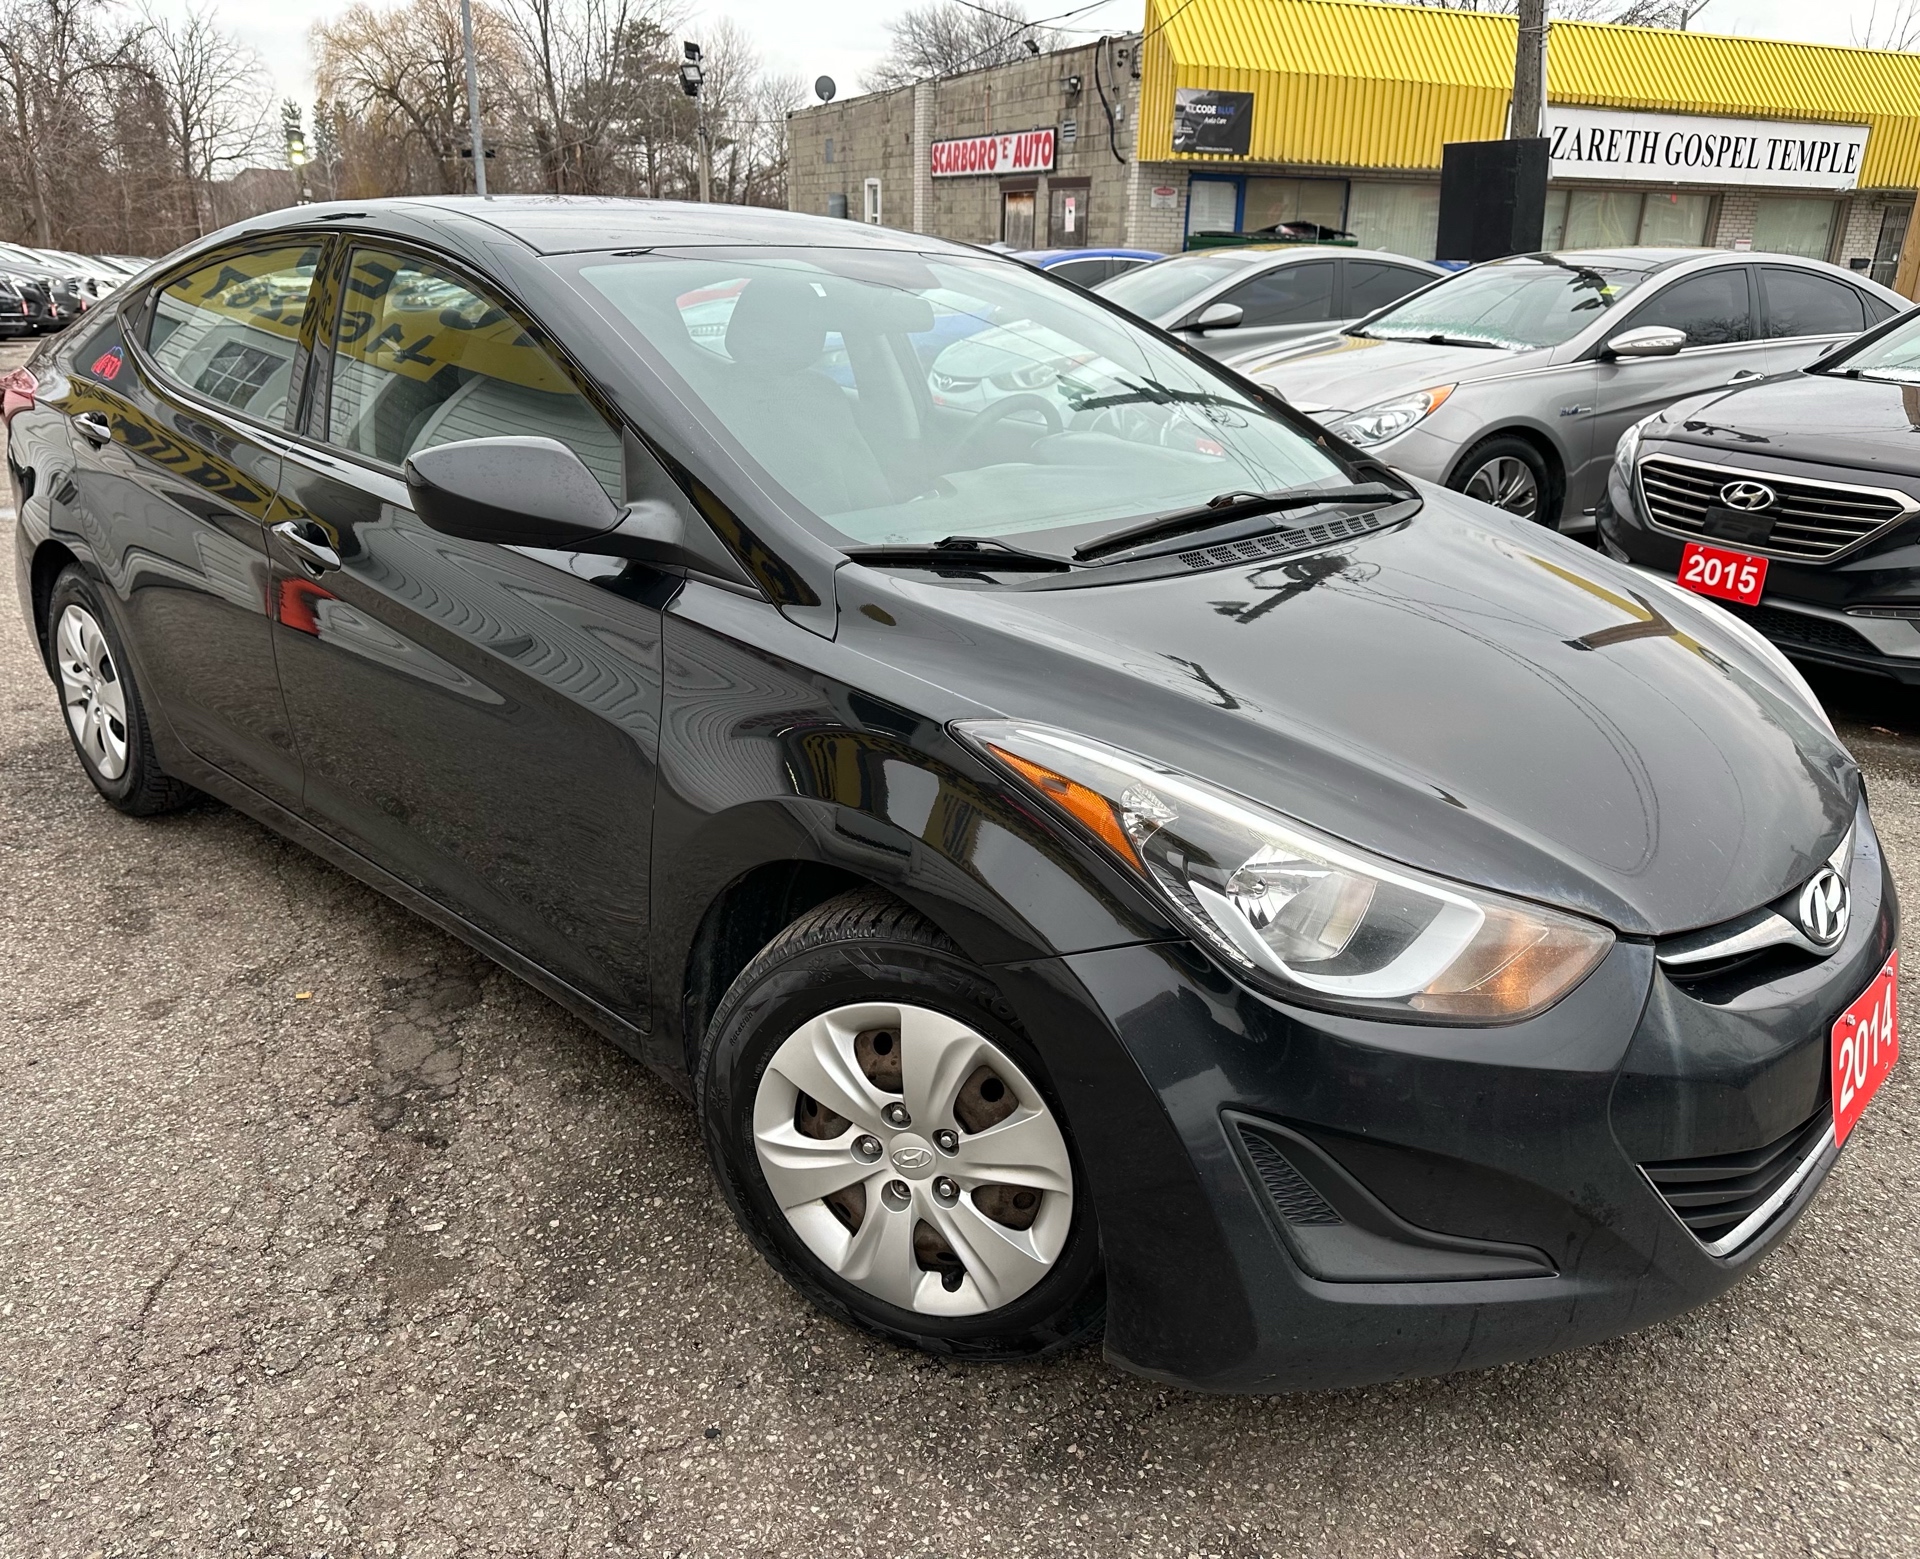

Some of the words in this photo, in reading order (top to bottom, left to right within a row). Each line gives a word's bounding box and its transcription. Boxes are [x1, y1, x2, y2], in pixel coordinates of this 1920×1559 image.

[931, 136, 996, 174] SCARBORO
[1012, 131, 1052, 168] AUTO
[1539, 125, 1661, 164] ZARETH
[1664, 131, 1761, 169] GOSPEL
[1766, 137, 1861, 174] TEMPLE
[1684, 554, 1758, 594] 2015
[1838, 982, 1893, 1113] 2014
